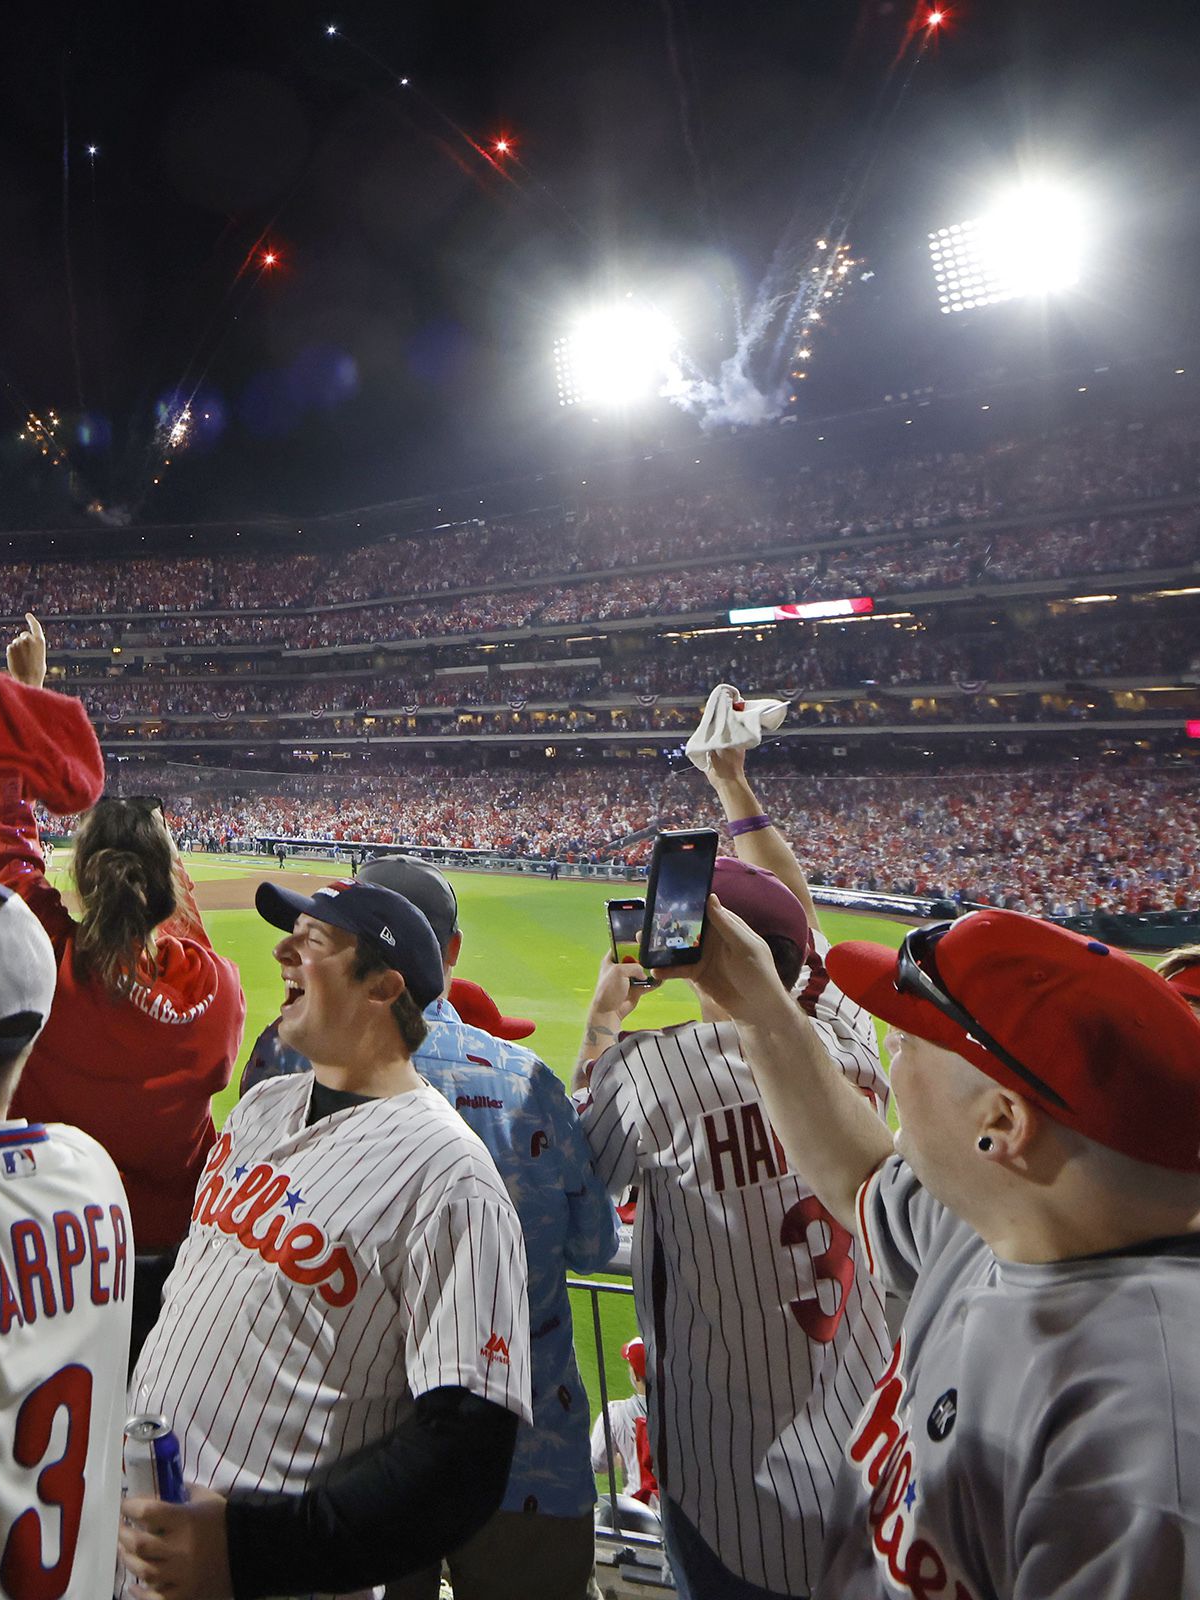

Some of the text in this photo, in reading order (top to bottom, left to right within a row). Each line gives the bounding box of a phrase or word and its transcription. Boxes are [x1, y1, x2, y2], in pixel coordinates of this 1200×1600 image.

[191, 1131, 360, 1310] Phillies
[780, 1194, 855, 1343] 3
[0, 1363, 93, 1600] 3
